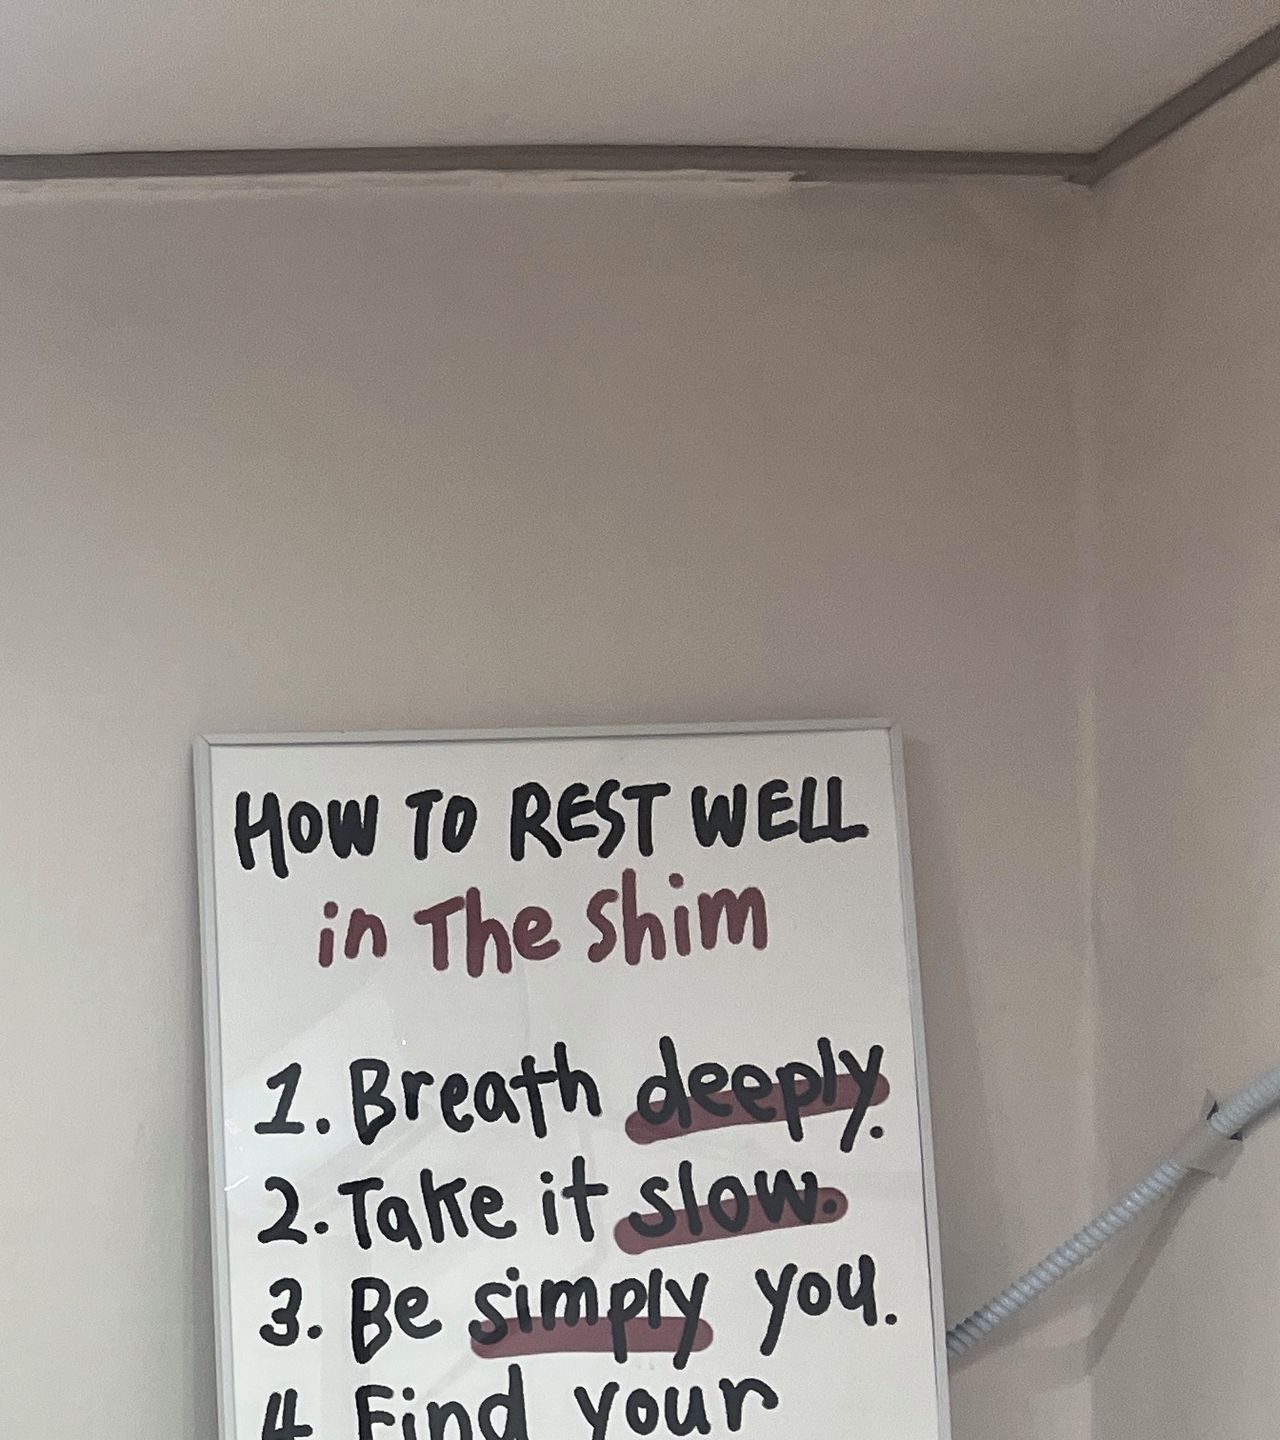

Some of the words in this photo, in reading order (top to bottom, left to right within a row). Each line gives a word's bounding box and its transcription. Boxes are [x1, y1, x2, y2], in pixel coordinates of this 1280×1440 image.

[235, 791, 379, 878] HOW
[405, 789, 478, 860] TO
[509, 779, 670, 861] REST
[691, 776, 869, 848] WELL
[317, 901, 388, 968] in
[414, 887, 561, 978] The
[254, 1062, 330, 1135] 1.
[350, 1042, 603, 1146] Breath
[636, 1036, 886, 1152] deeply.
[258, 1177, 329, 1244] 2.
[339, 1169, 518, 1250] Take
[540, 1156, 609, 1242] it
[629, 1160, 838, 1239] slow.
[259, 1277, 323, 1347] 3.
[351, 1277, 443, 1364] Be
[468, 1267, 710, 1370] simply
[755, 1254, 899, 1356] you.
